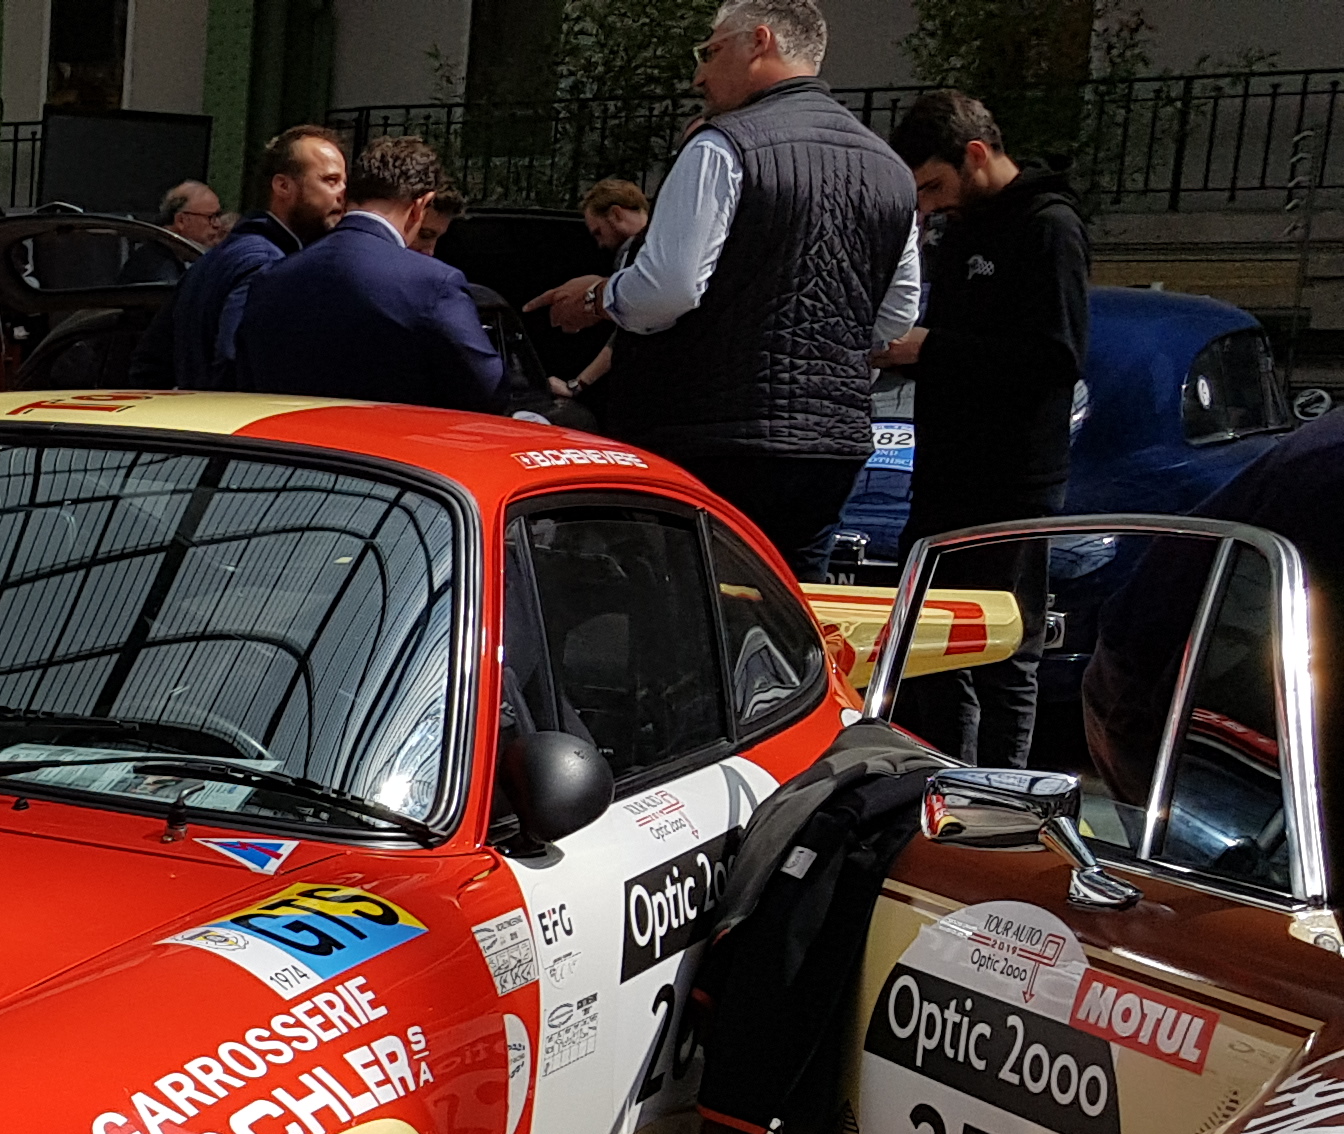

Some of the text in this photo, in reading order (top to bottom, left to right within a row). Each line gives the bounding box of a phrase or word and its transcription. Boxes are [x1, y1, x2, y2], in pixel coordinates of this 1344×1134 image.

[230, 886, 400, 957] GTS
[537, 903, 574, 946] EFG
[629, 866, 698, 959] Optic
[983, 914, 1043, 947] TOUR AUTO
[269, 964, 310, 992] 1974
[970, 948, 1027, 982] Optic 2000
[887, 974, 1109, 1117] Optic 2000
[1076, 980, 1208, 1063] MOTUL
